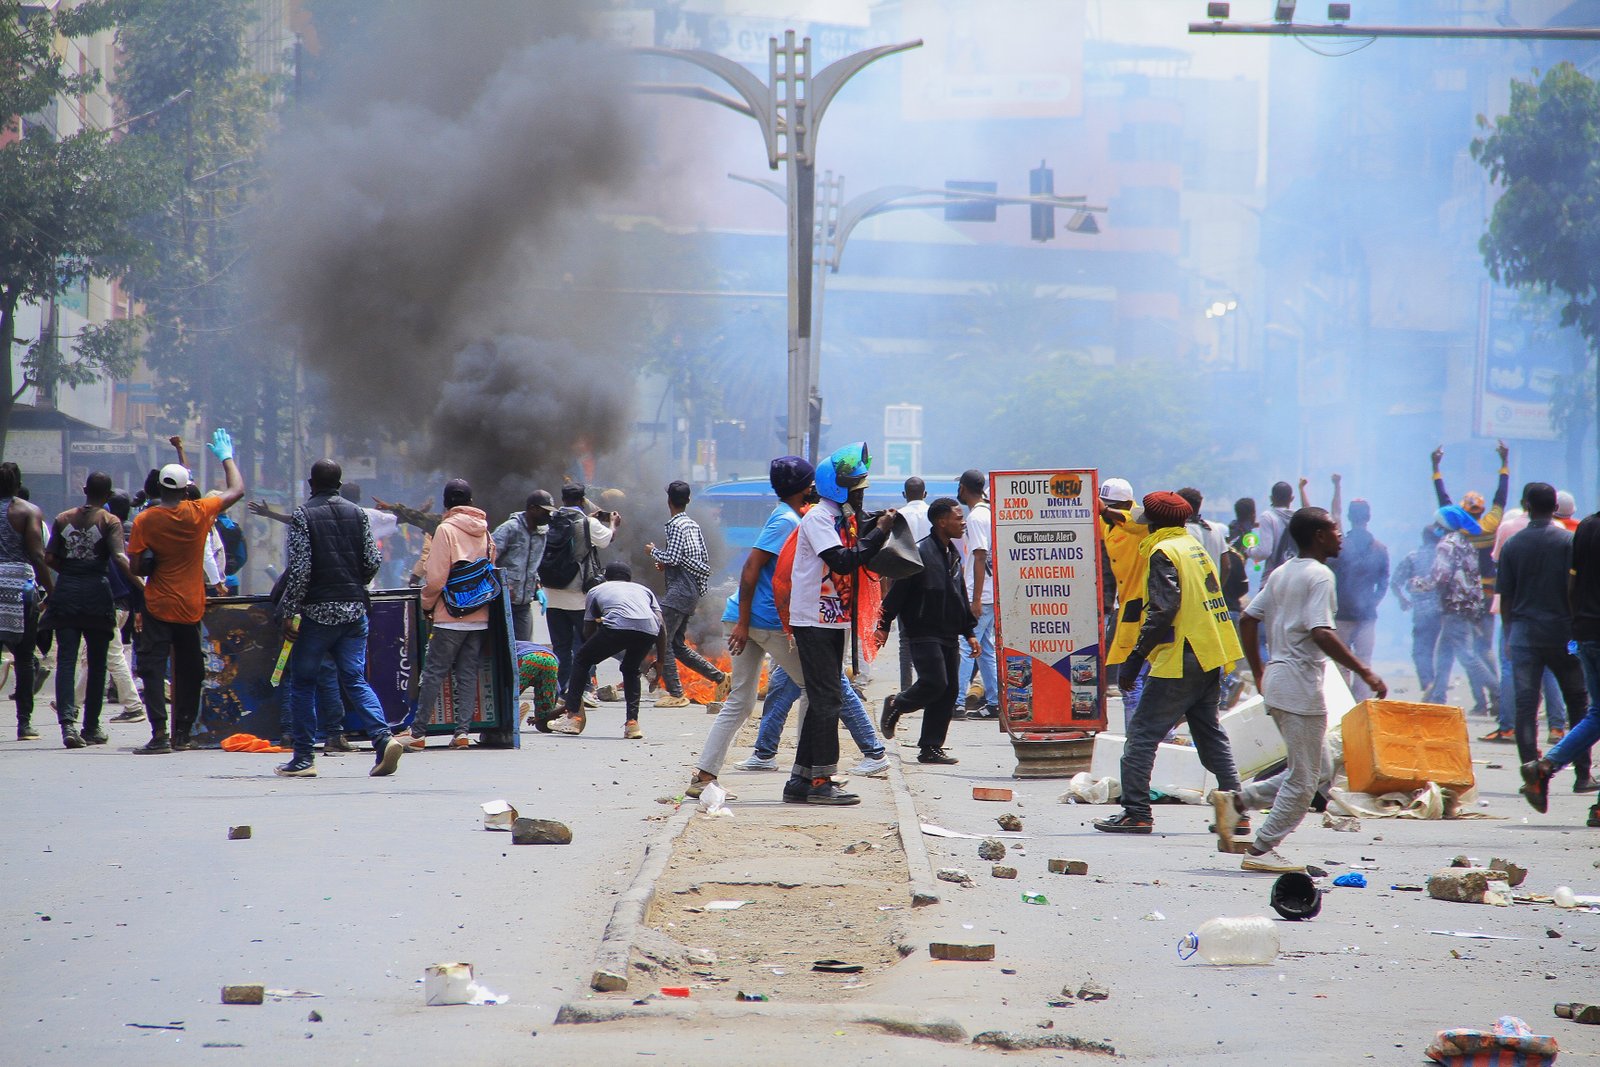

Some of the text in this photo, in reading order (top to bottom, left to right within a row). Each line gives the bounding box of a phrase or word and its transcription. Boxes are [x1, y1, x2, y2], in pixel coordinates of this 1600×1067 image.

[1011, 480, 1049, 494] ROUTE
[1003, 497, 1029, 509] KMO
[1047, 497, 1083, 507] DIGITAL
[998, 509, 1034, 520] SACCO
[1040, 509, 1091, 519] LUXURY LTD
[1017, 532, 1074, 542] New Route Alert
[1009, 547, 1084, 561] WESTLANDS
[1020, 566, 1075, 579] KANGEMI
[1025, 584, 1071, 598] UTHIRU
[1030, 603, 1069, 616] KINOO
[1030, 621, 1071, 634] REGEN
[1029, 639, 1074, 653] KIKUYU
